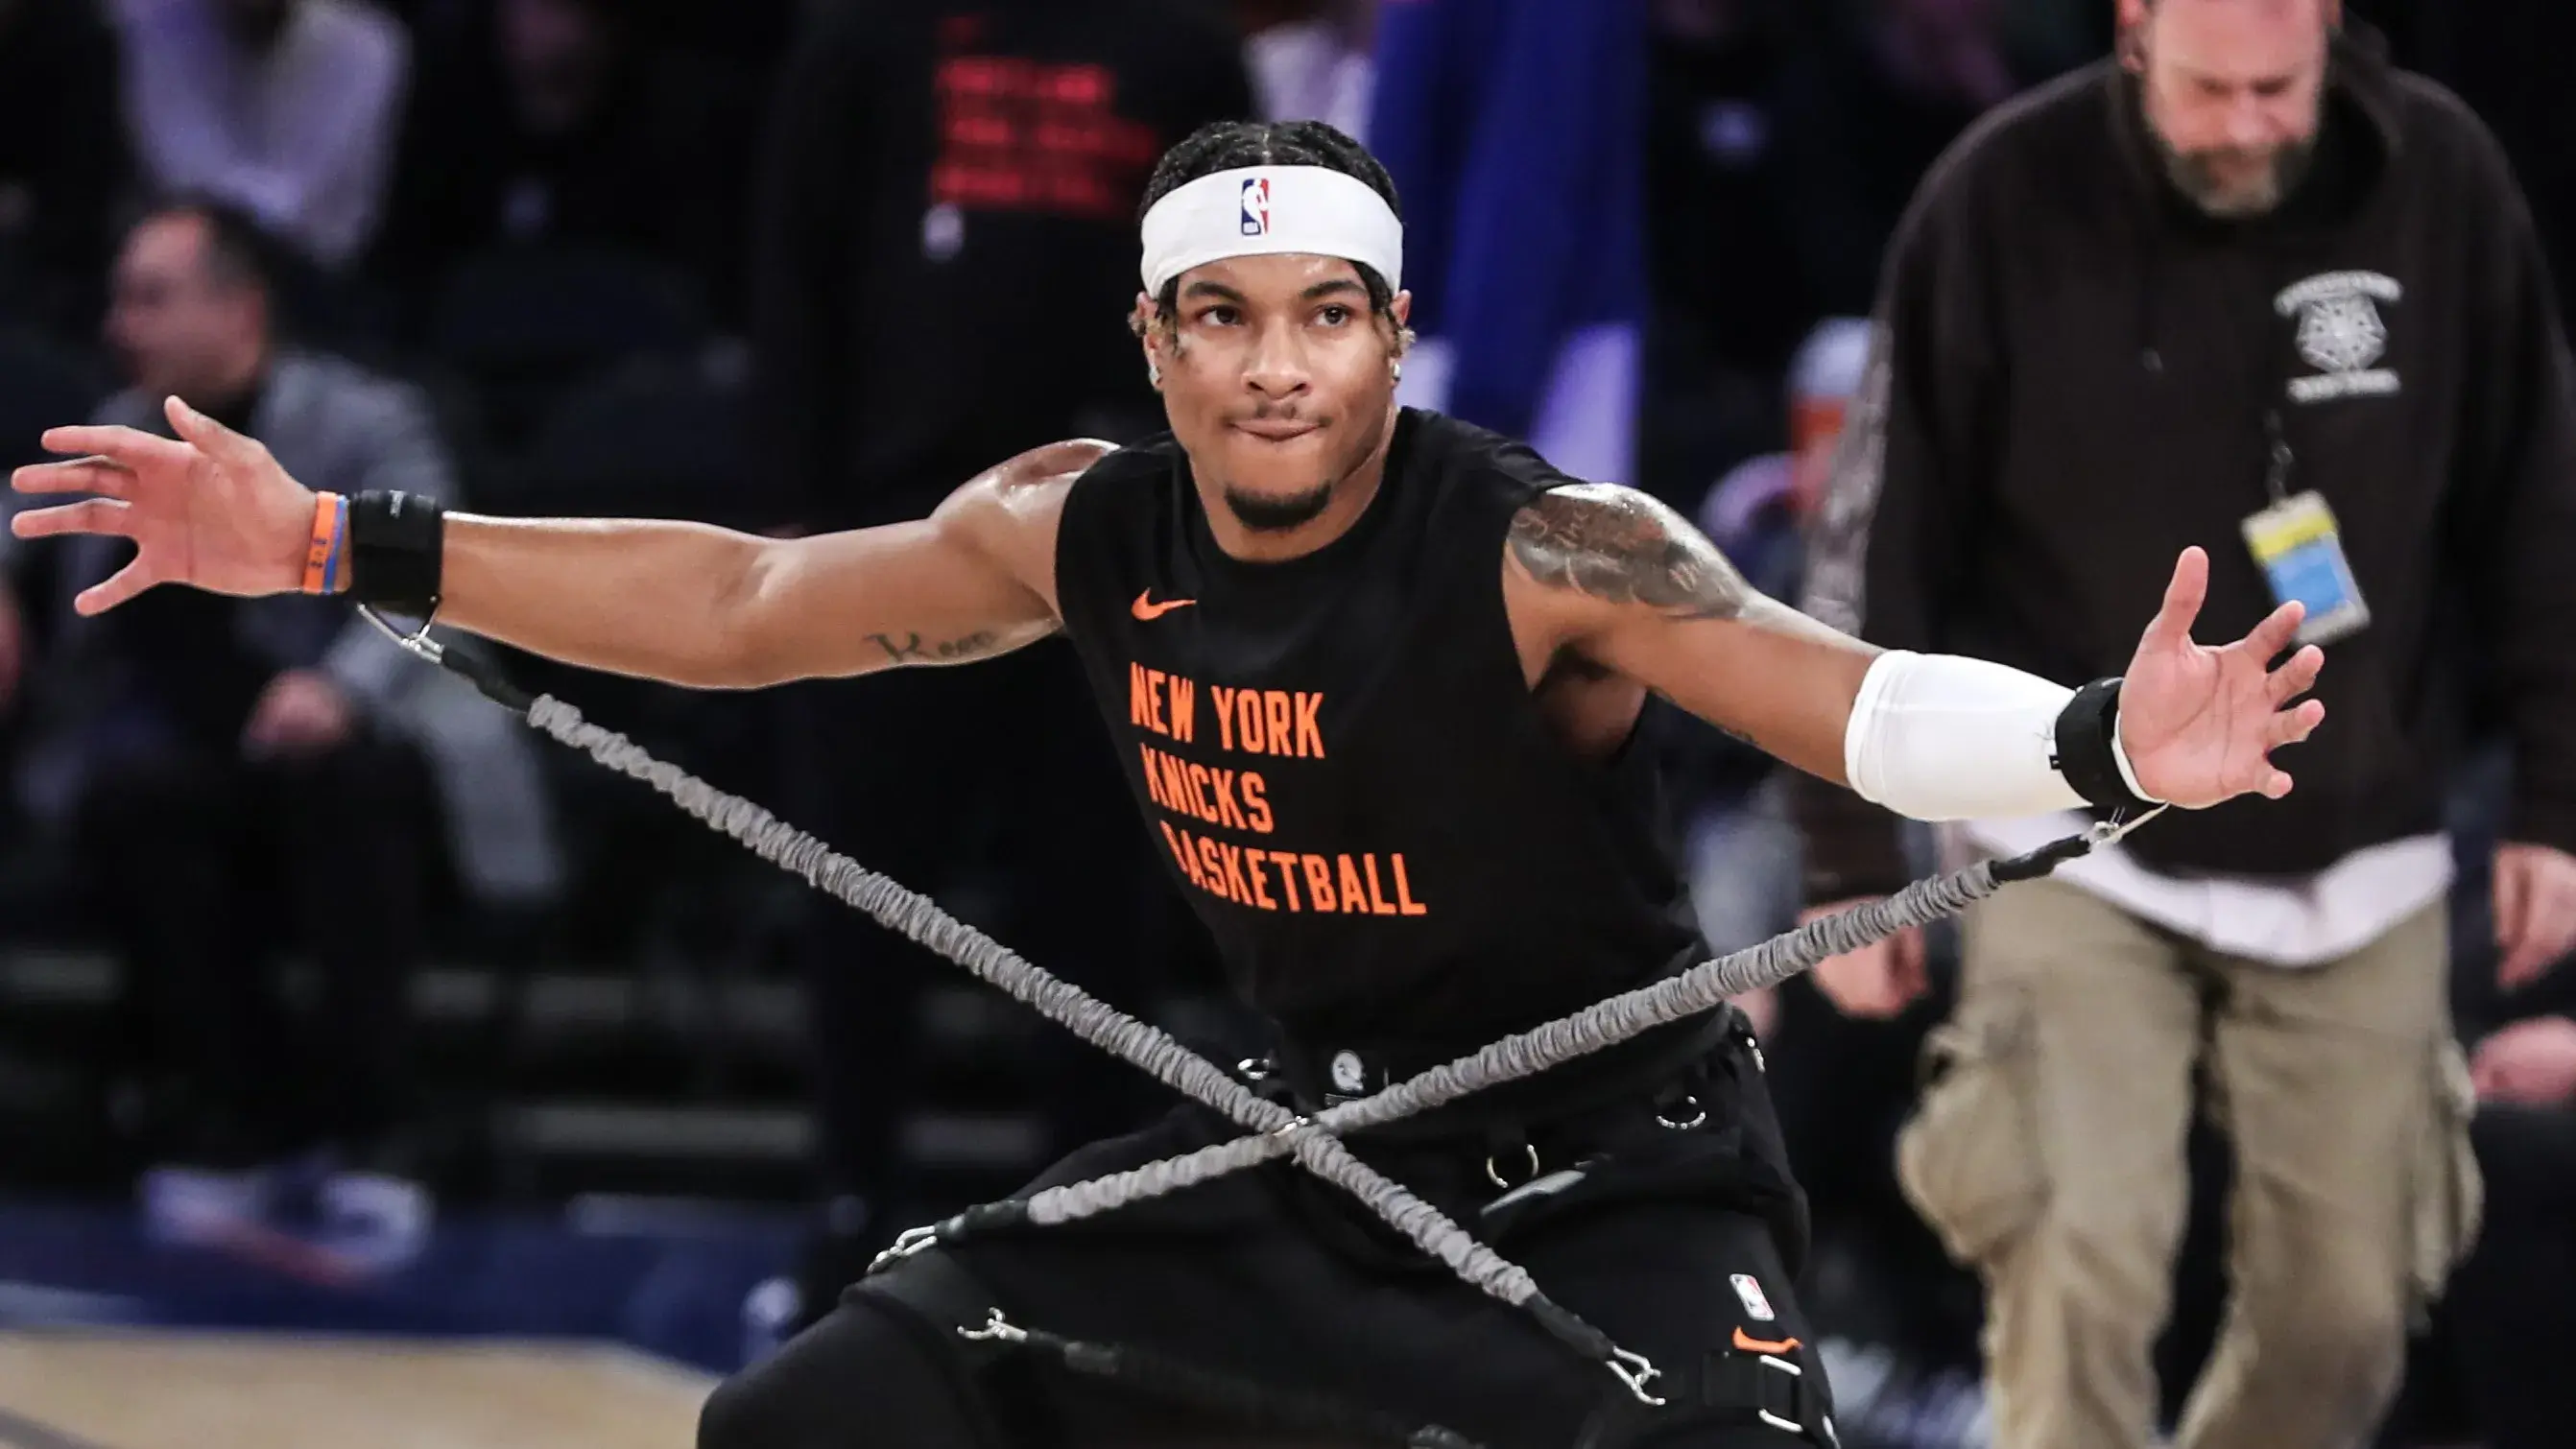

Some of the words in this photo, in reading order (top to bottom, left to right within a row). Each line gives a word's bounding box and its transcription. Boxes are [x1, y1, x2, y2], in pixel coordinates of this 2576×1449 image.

[1130, 661, 1195, 743] NEW
[1210, 685, 1325, 759] YORK
[1140, 743, 1275, 834] KNICKS
